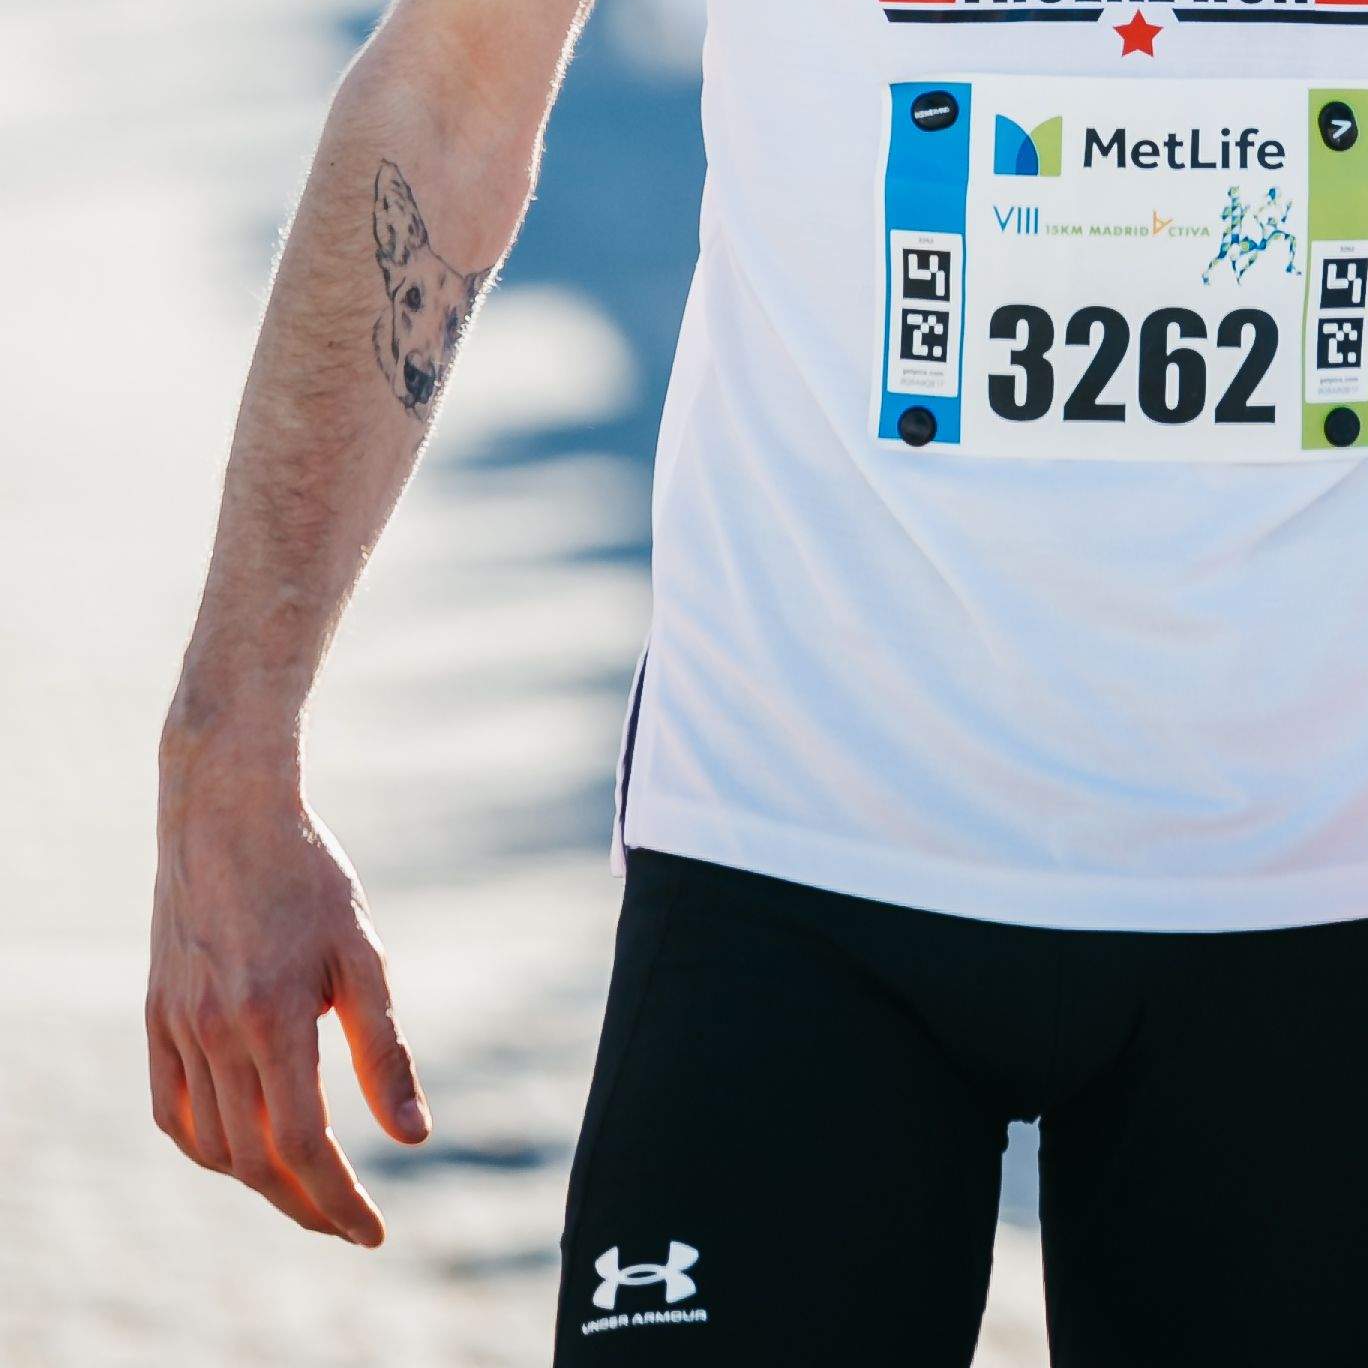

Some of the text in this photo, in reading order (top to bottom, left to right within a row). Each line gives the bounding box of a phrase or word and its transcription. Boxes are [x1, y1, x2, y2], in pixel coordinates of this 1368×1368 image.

[1082, 127, 1287, 171] MetLife
[992, 205, 1040, 237] VIII
[1045, 224, 1084, 237] 15KM
[987, 303, 1280, 425] 3262
